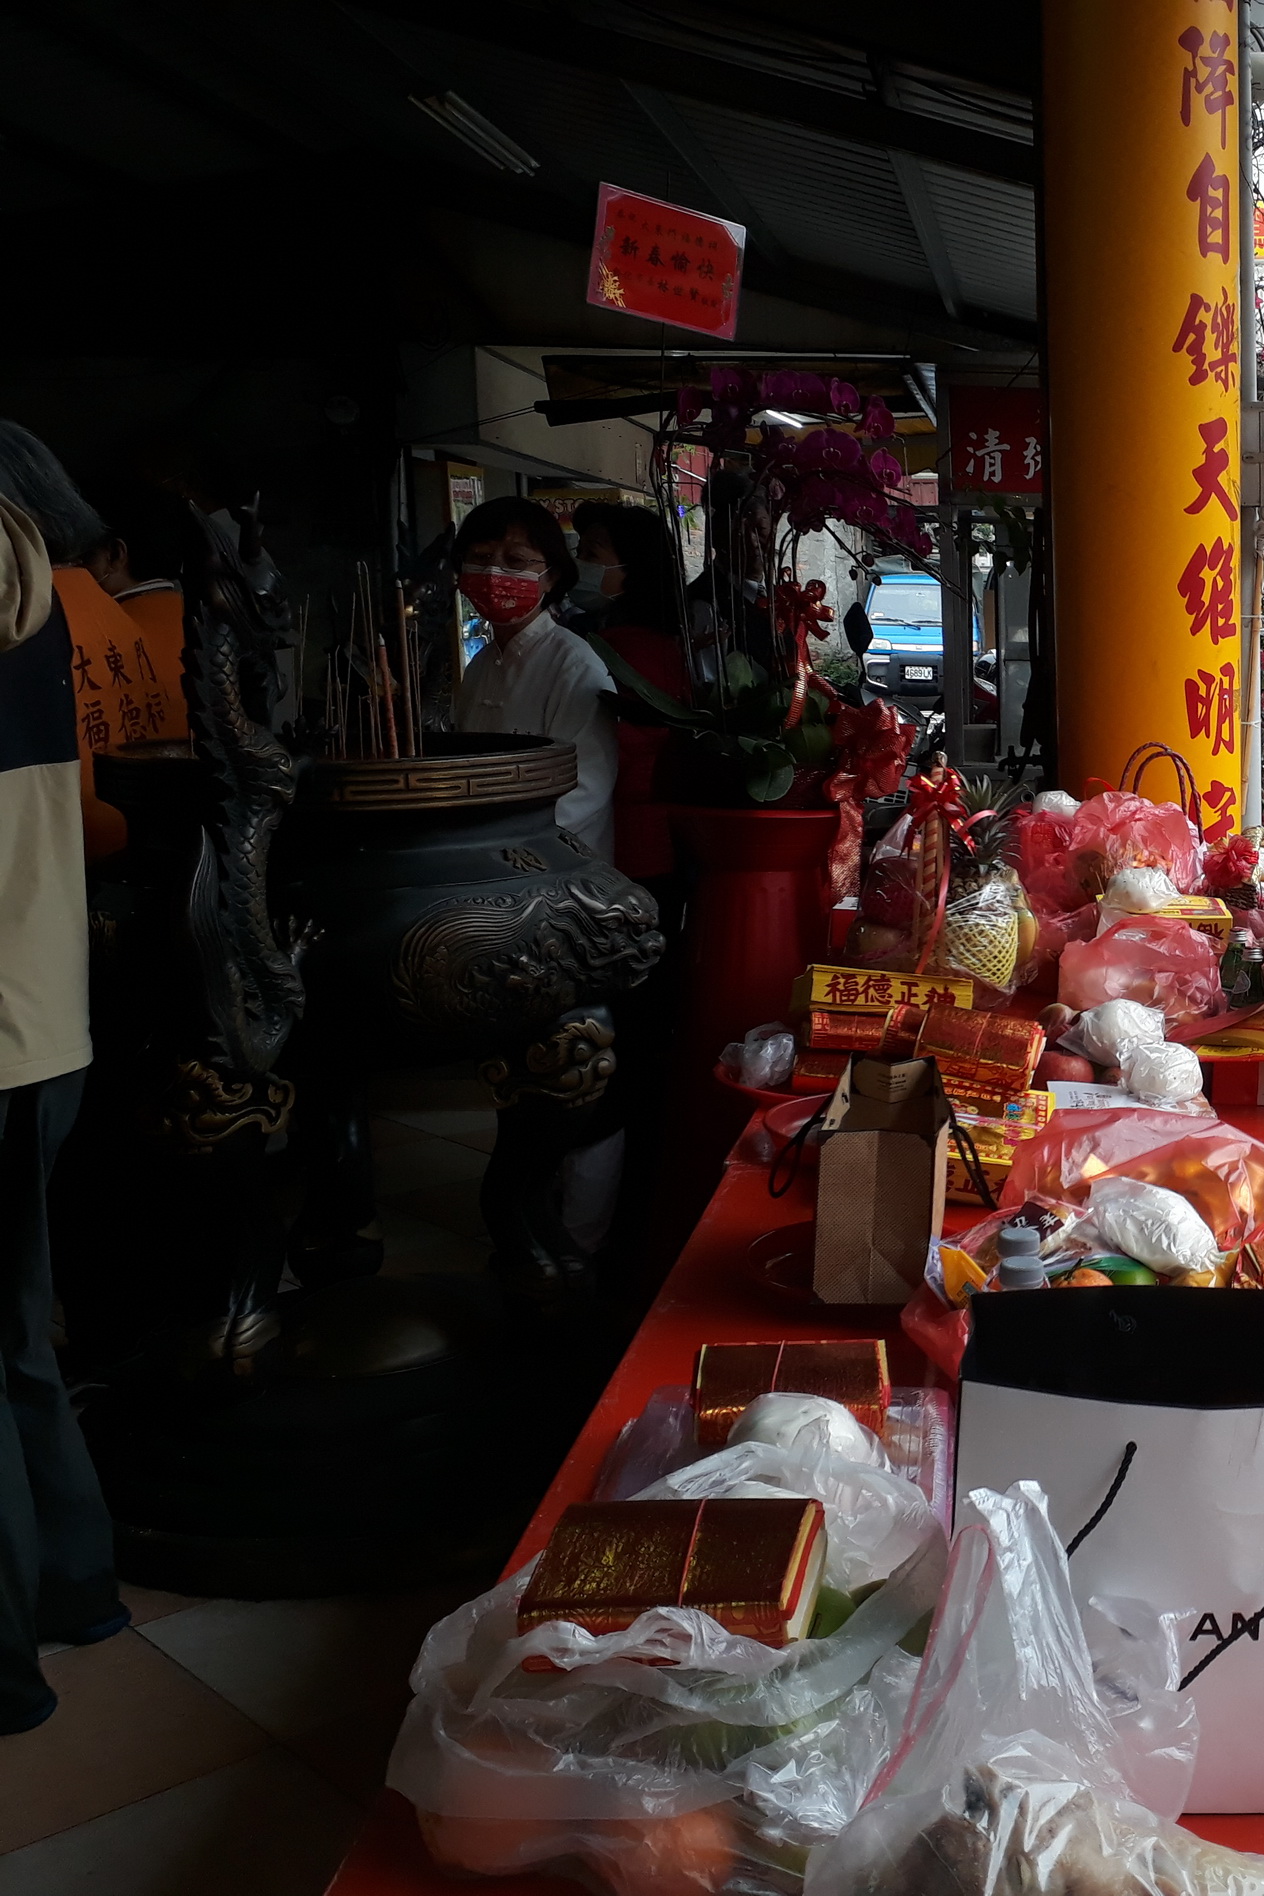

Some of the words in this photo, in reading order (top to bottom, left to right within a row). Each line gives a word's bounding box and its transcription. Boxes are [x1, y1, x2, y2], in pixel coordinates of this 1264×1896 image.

[620, 235, 715, 281] 新春愉快
[73, 636, 158, 694] 大東門
[824, 973, 957, 1008] 福德正神
